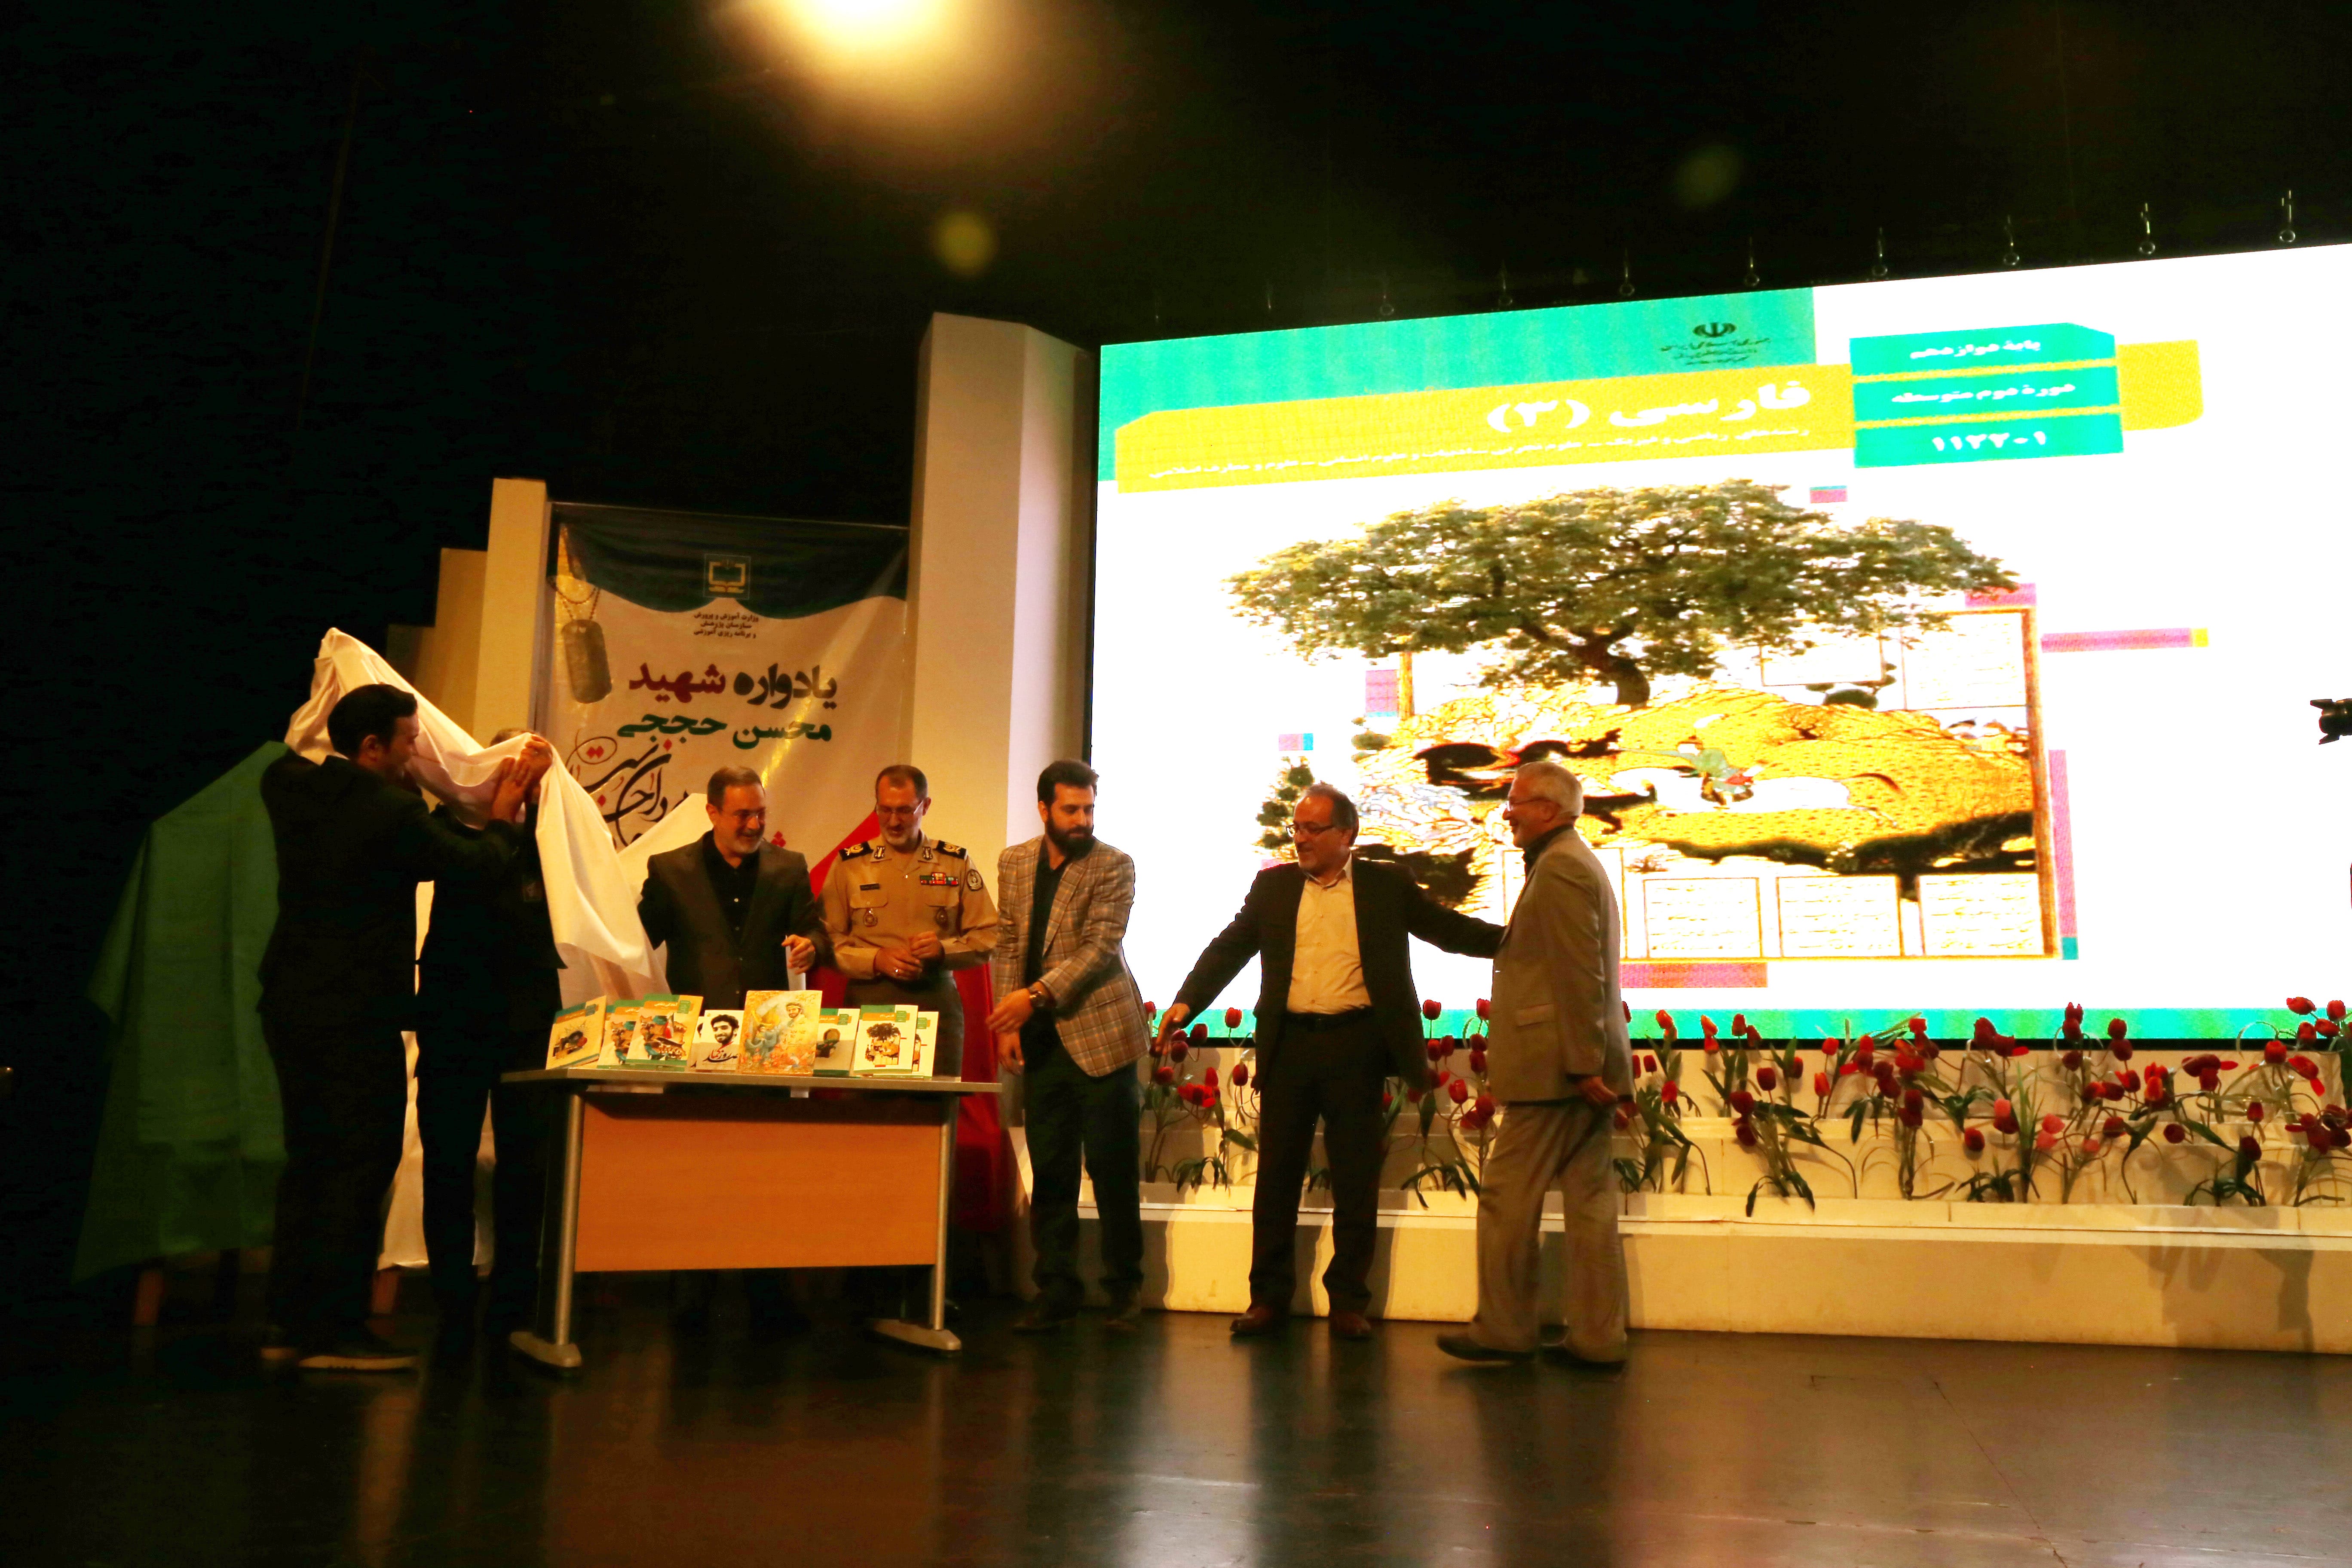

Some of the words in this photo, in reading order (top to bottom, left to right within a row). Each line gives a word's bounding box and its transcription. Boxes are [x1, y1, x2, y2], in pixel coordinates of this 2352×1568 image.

[1910, 343, 2000, 359] دوازدهم
[1609, 380, 1811, 427] فارسی
[1891, 390, 1974, 403] متوسطه
[1977, 387, 2019, 400] دوم
[629, 662, 726, 703] شهید
[733, 663, 837, 710] یادواره
[617, 714, 728, 743] حججی
[732, 720, 832, 750] محسن
